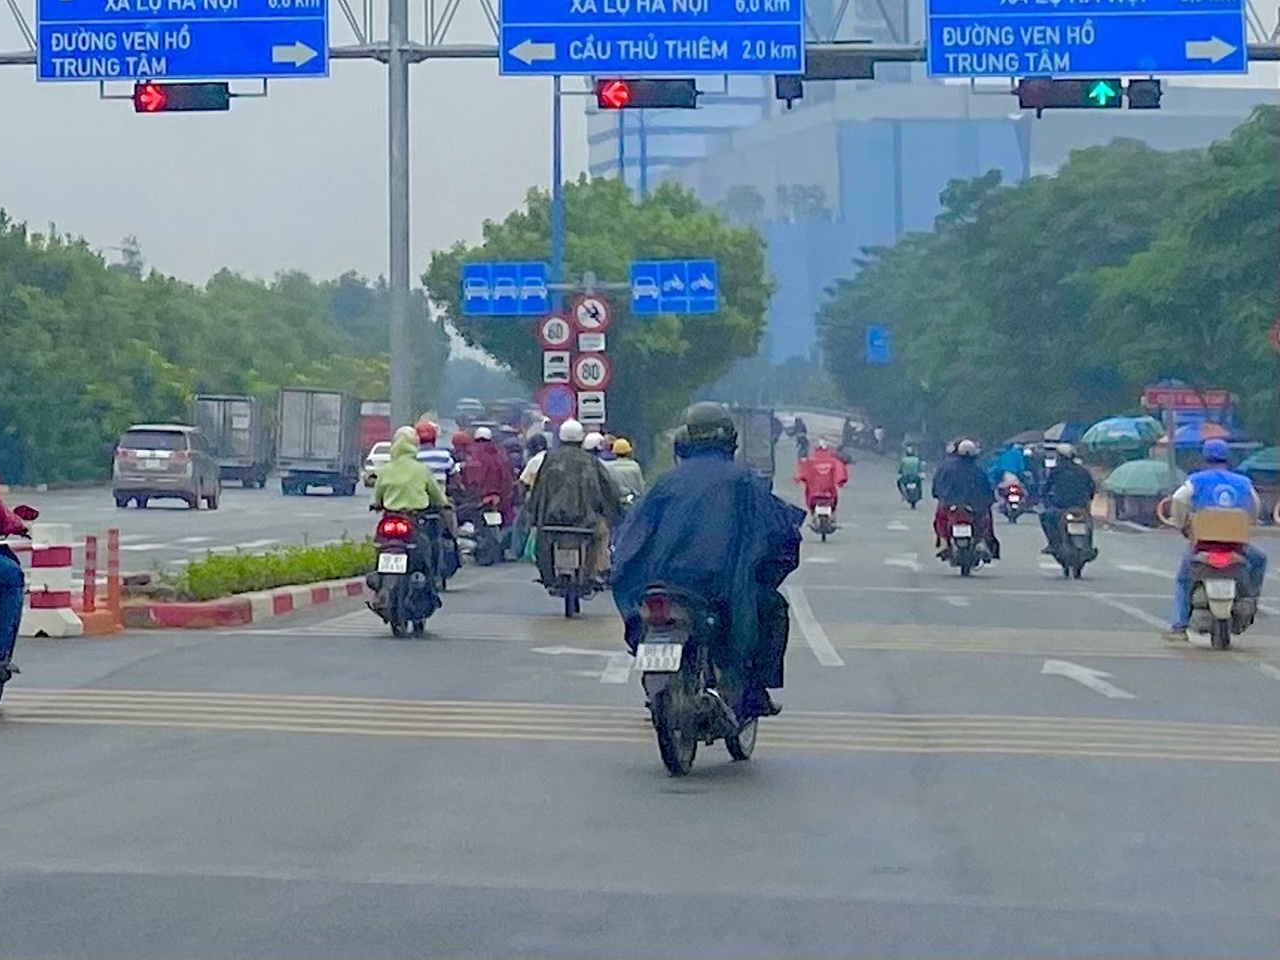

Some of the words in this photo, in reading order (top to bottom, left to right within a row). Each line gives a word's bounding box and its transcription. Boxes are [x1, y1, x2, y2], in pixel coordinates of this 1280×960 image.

[51, 26, 118, 52] ĐƯỜNG
[121, 31, 160, 51] VEN
[568, 33, 611, 60] CẦU
[616, 33, 659, 60] THỦ
[664, 35, 728, 60] THIÊM
[942, 22, 1015, 46] ĐƯỜNG
[1020, 25, 1061, 45] VEN
[770, 40, 797, 59] km
[944, 52, 1020, 73] TRUNG
[1024, 48, 1070, 72] TÂM
[51, 57, 121, 77] TRUNG
[125, 52, 167, 76] TÂM
[581, 363, 601, 381] 80
